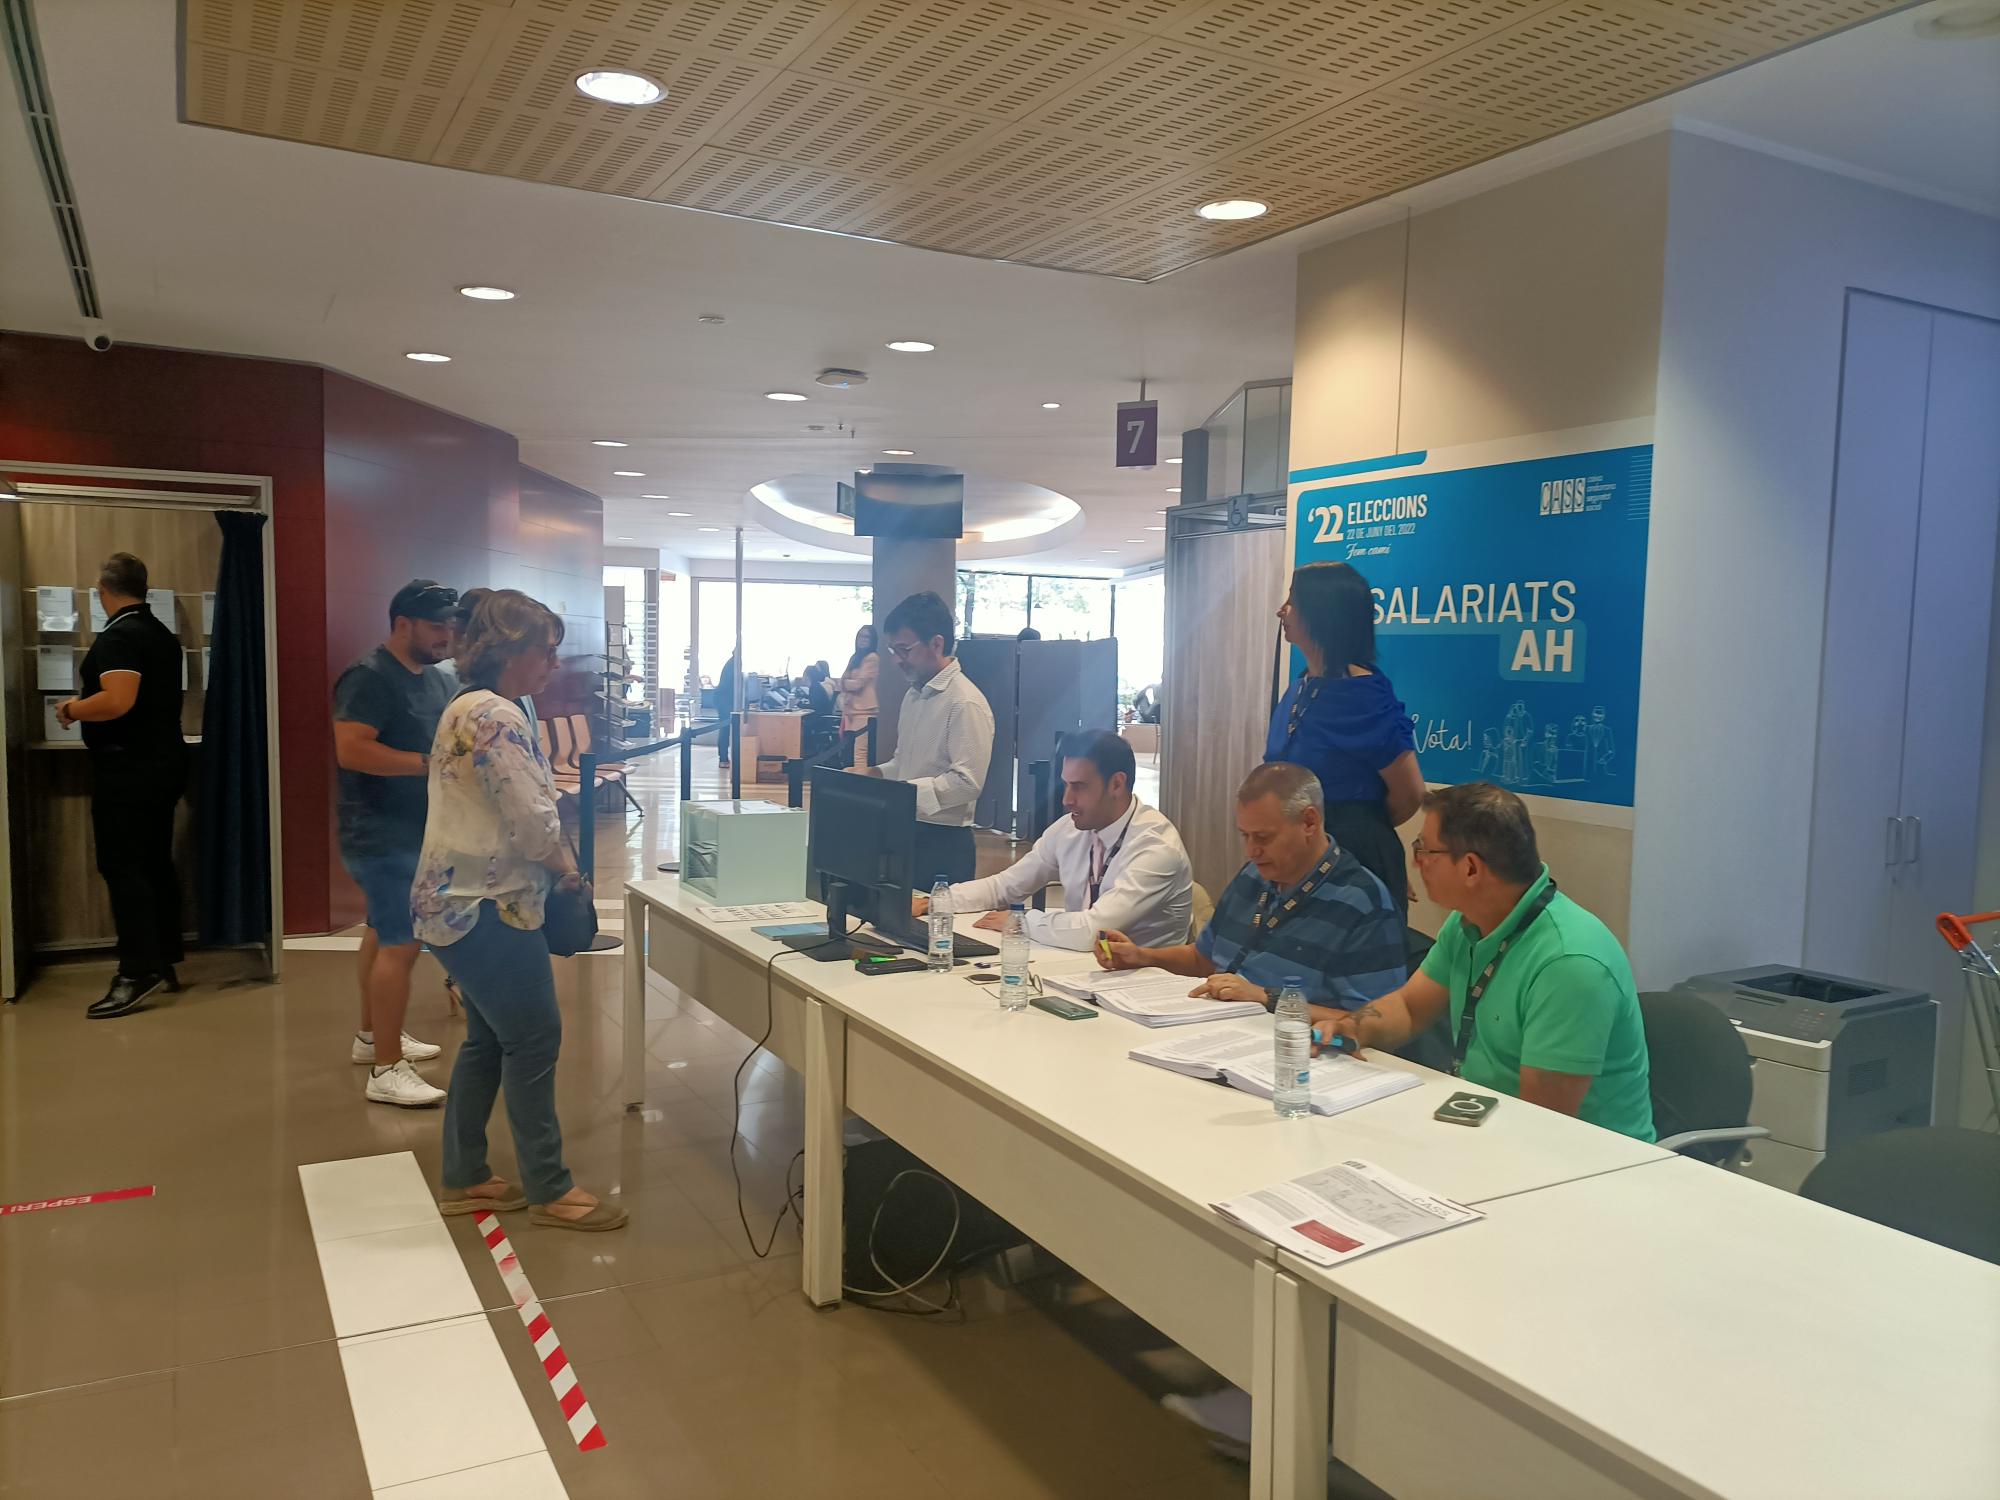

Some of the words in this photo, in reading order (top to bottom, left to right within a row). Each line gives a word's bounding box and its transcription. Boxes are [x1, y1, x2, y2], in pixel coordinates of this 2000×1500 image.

[1127, 420, 1145, 453] 7
[1347, 494, 1428, 525] ELECCIONS
[1540, 477, 1586, 516] CASS
[1346, 528, 1355, 540] 22
[1356, 527, 1364, 539] DE
[1366, 525, 1383, 538] JUNY
[1384, 524, 1397, 536] DEL
[1398, 522, 1416, 535] 2022
[1510, 629, 1574, 673] AH
[1411, 713, 1472, 754] Vota!
[10, 1195, 92, 1213] ESPERI
